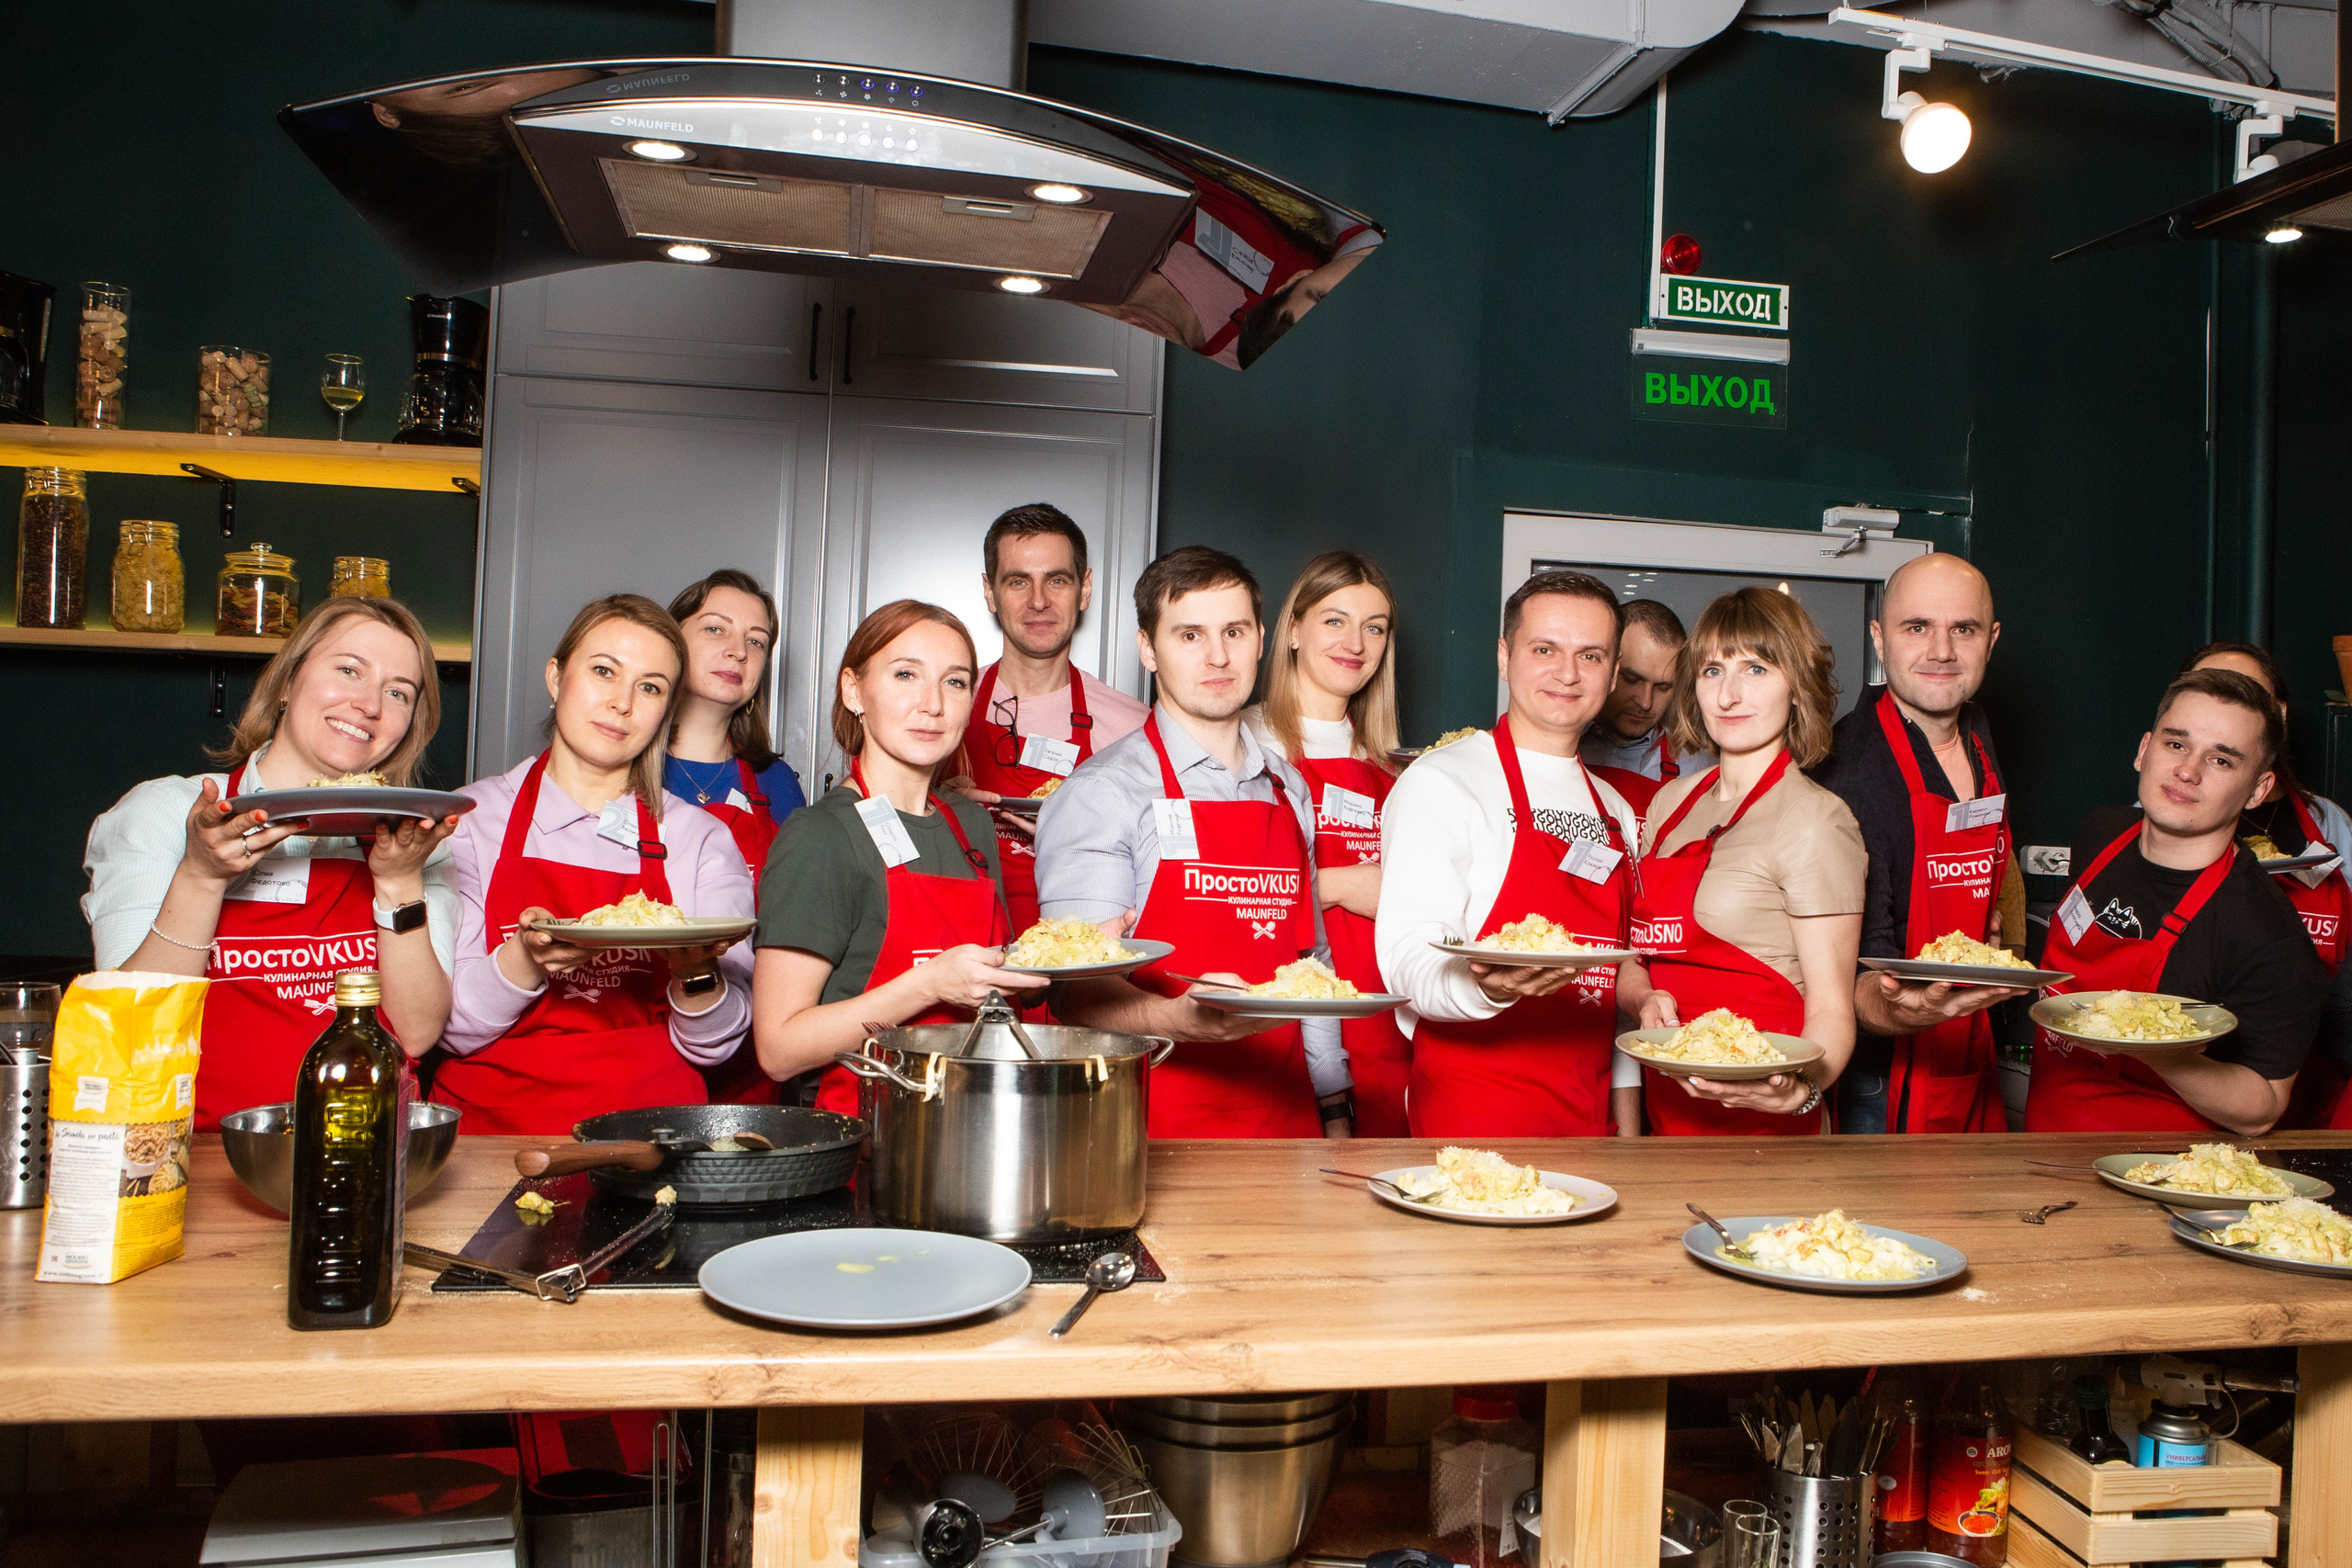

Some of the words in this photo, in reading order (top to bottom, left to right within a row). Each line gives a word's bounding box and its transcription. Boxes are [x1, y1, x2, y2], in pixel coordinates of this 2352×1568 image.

[627, 118, 694, 133] MAUNFELD
[1677, 286, 1771, 321] ВЫХОД
[1645, 371, 1776, 415] ВЫХОД
[1963, 876, 1992, 886] КУЛИНА
[1228, 897, 1271, 906] КУЛИНАРНАЯ
[1237, 908, 1287, 919] MAUNFELD
[264, 970, 334, 983] КУЛИНАРНАЯ
[595, 965, 630, 976] СТУДИЯ
[277, 981, 336, 999] MAUNF
